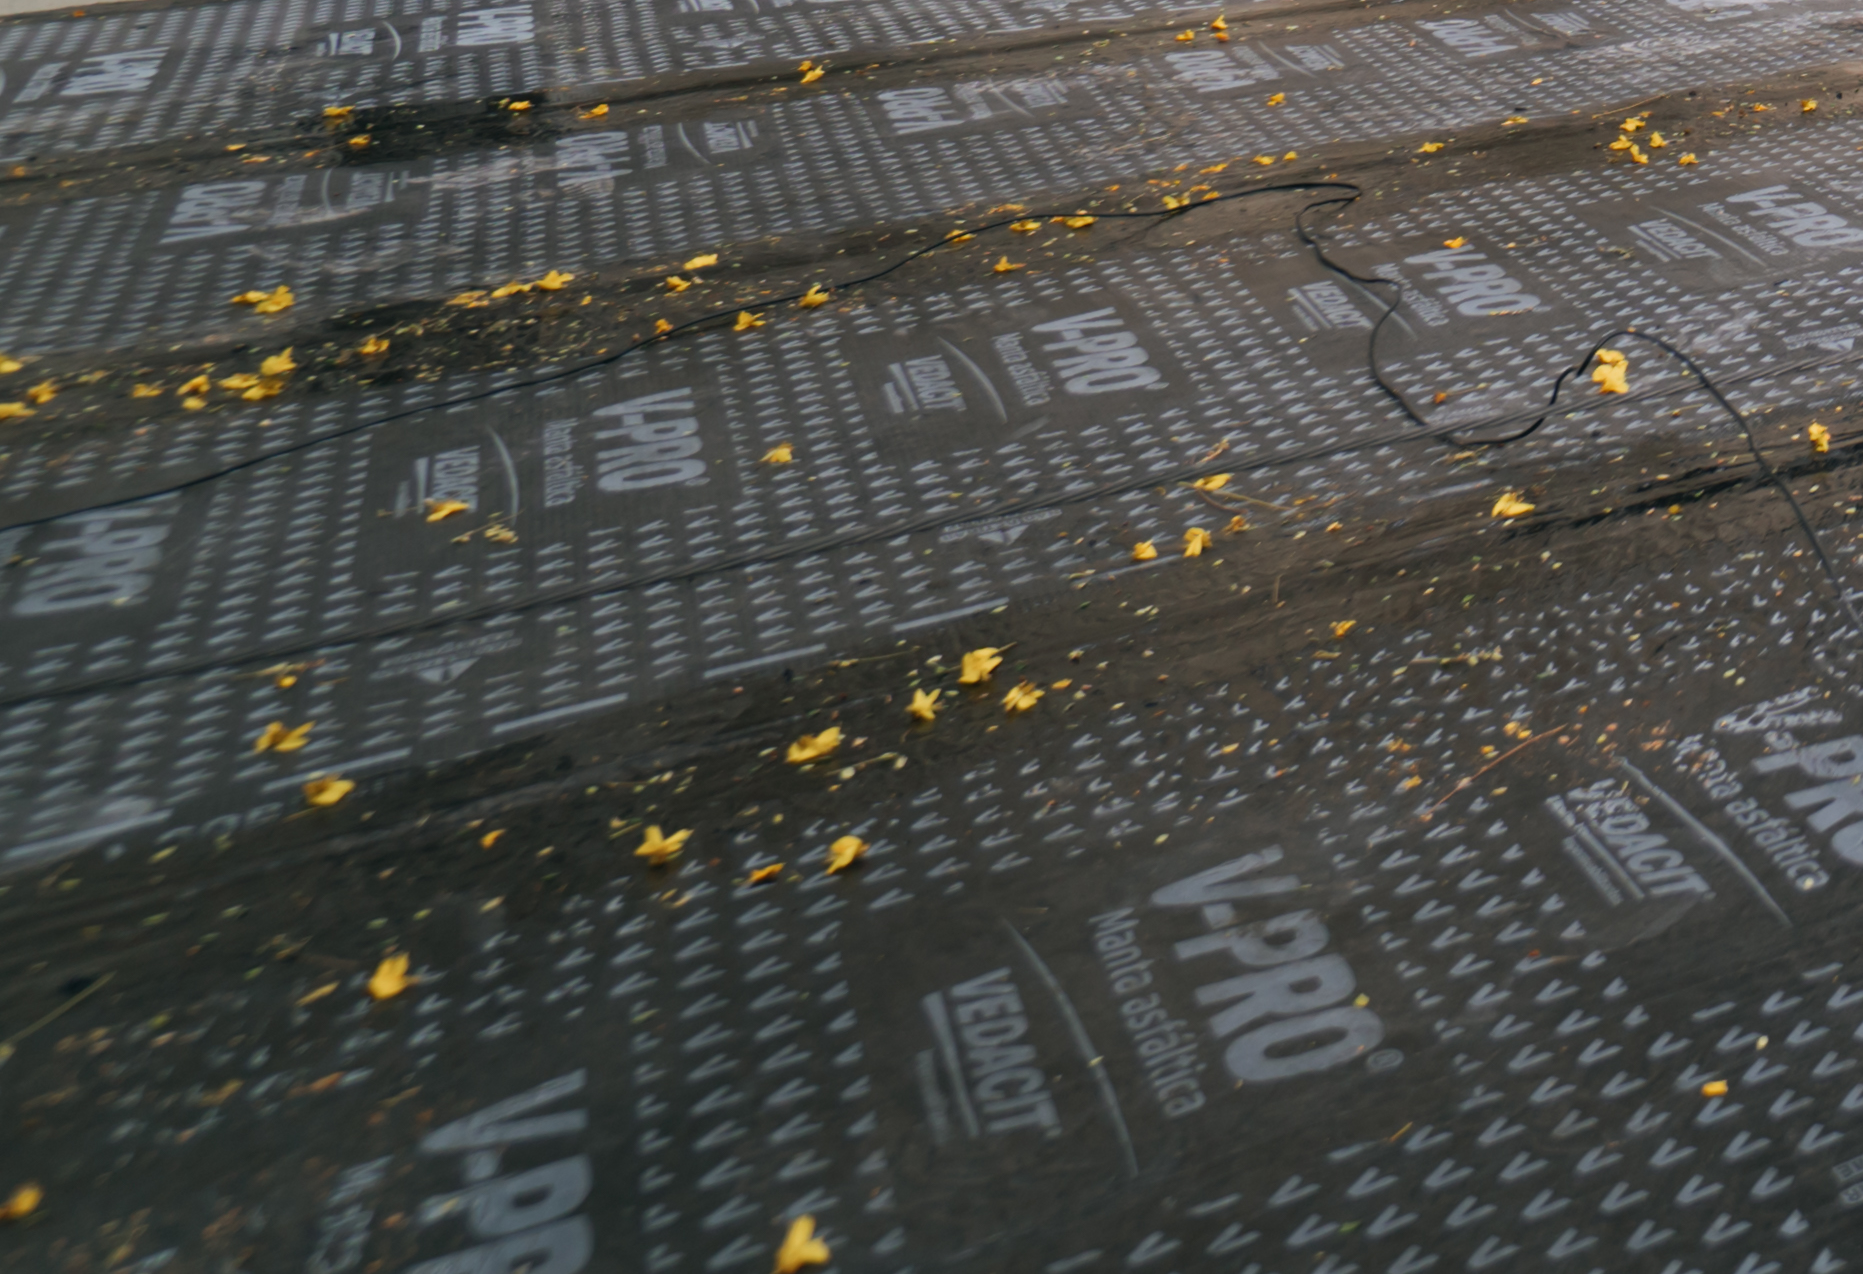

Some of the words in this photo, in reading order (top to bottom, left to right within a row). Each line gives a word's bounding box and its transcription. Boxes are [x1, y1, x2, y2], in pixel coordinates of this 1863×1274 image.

[1403, 243, 1542, 318] V-PRO
[1638, 218, 1724, 260] VEDACIT
[1029, 306, 1163, 396] V-PRO
[1301, 280, 1376, 330] VEDACIT
[904, 354, 968, 413] VEDACIT
[593, 386, 708, 494] V-PRO
[1565, 776, 1712, 899] VEDACIT
[1724, 795, 1832, 893] asfáltica
[1088, 905, 1154, 997] Manta
[1150, 843, 1386, 1083] V-PRO
[949, 965, 1056, 1137] VEDACIT
[1118, 992, 1207, 1121] asfáltica
